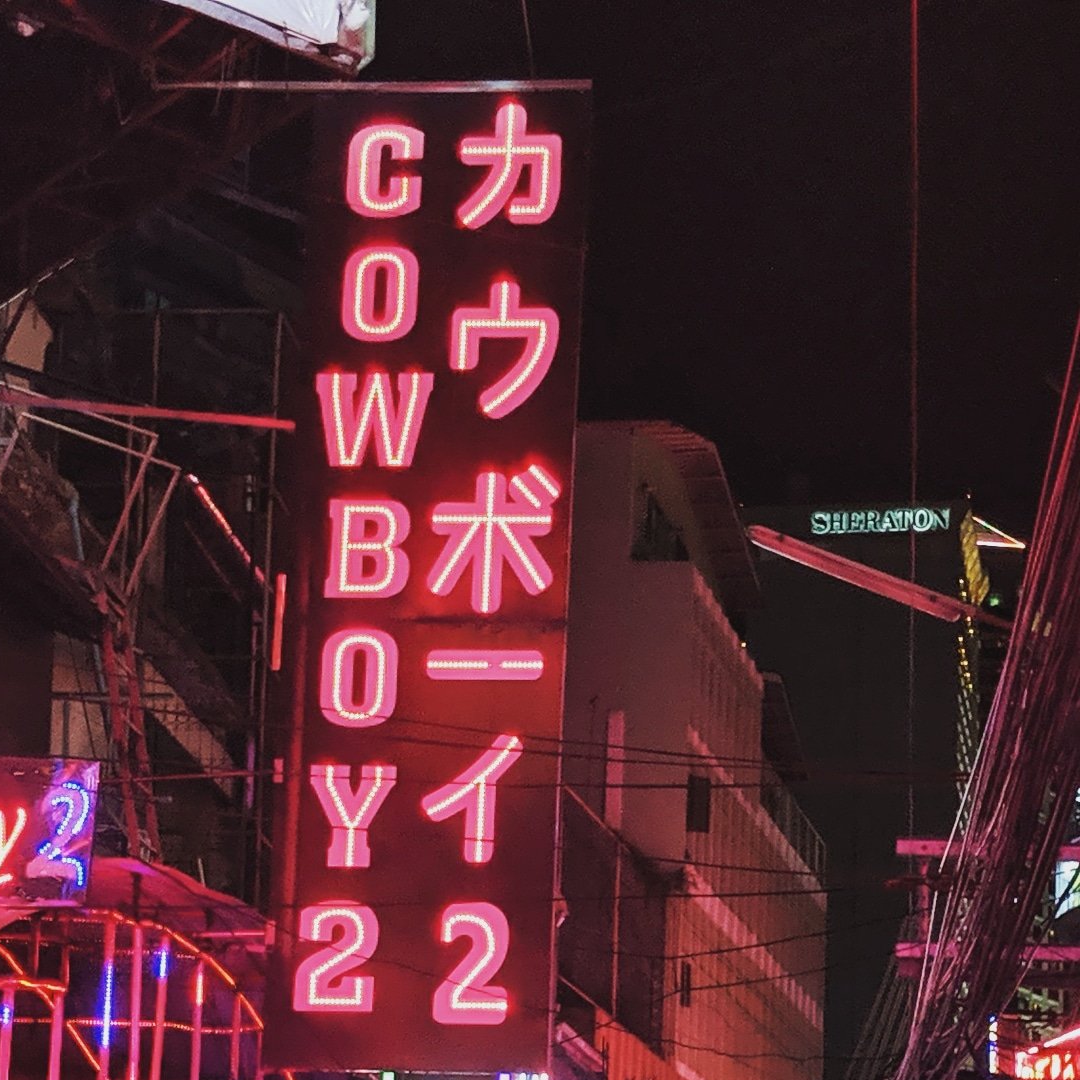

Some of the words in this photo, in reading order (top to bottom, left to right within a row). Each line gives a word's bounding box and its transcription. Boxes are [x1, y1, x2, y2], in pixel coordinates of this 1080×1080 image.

[310, 124, 434, 867] COWBOY
[810, 508, 951, 535] SHERATON
[25, 782, 90, 886] 2
[293, 902, 379, 1012] 2
